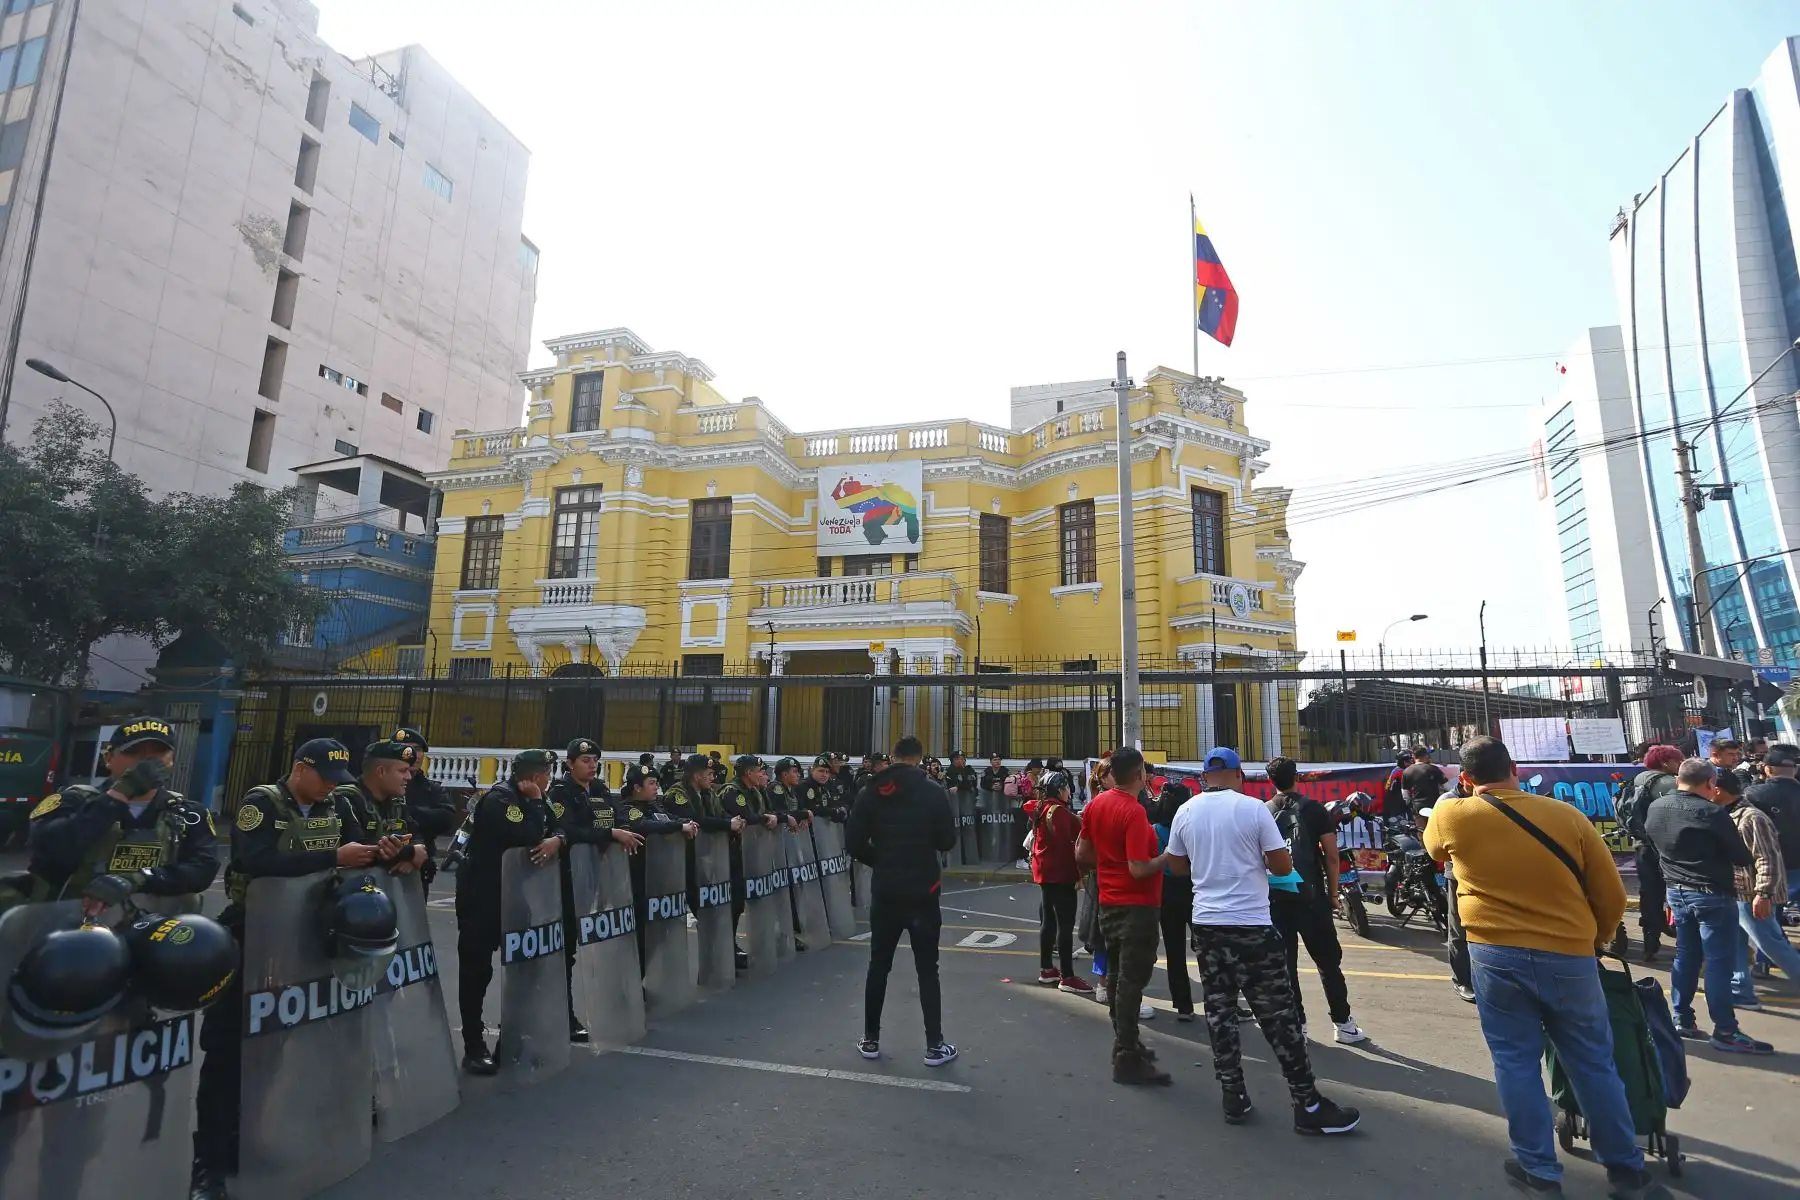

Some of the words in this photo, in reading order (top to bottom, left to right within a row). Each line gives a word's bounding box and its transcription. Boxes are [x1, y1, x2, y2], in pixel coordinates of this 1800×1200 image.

[829, 526, 851, 535] TODA
[124, 721, 169, 736] POLICIA
[981, 813, 1015, 824] POLICIA
[0, 1019, 190, 1101] POLICIA
